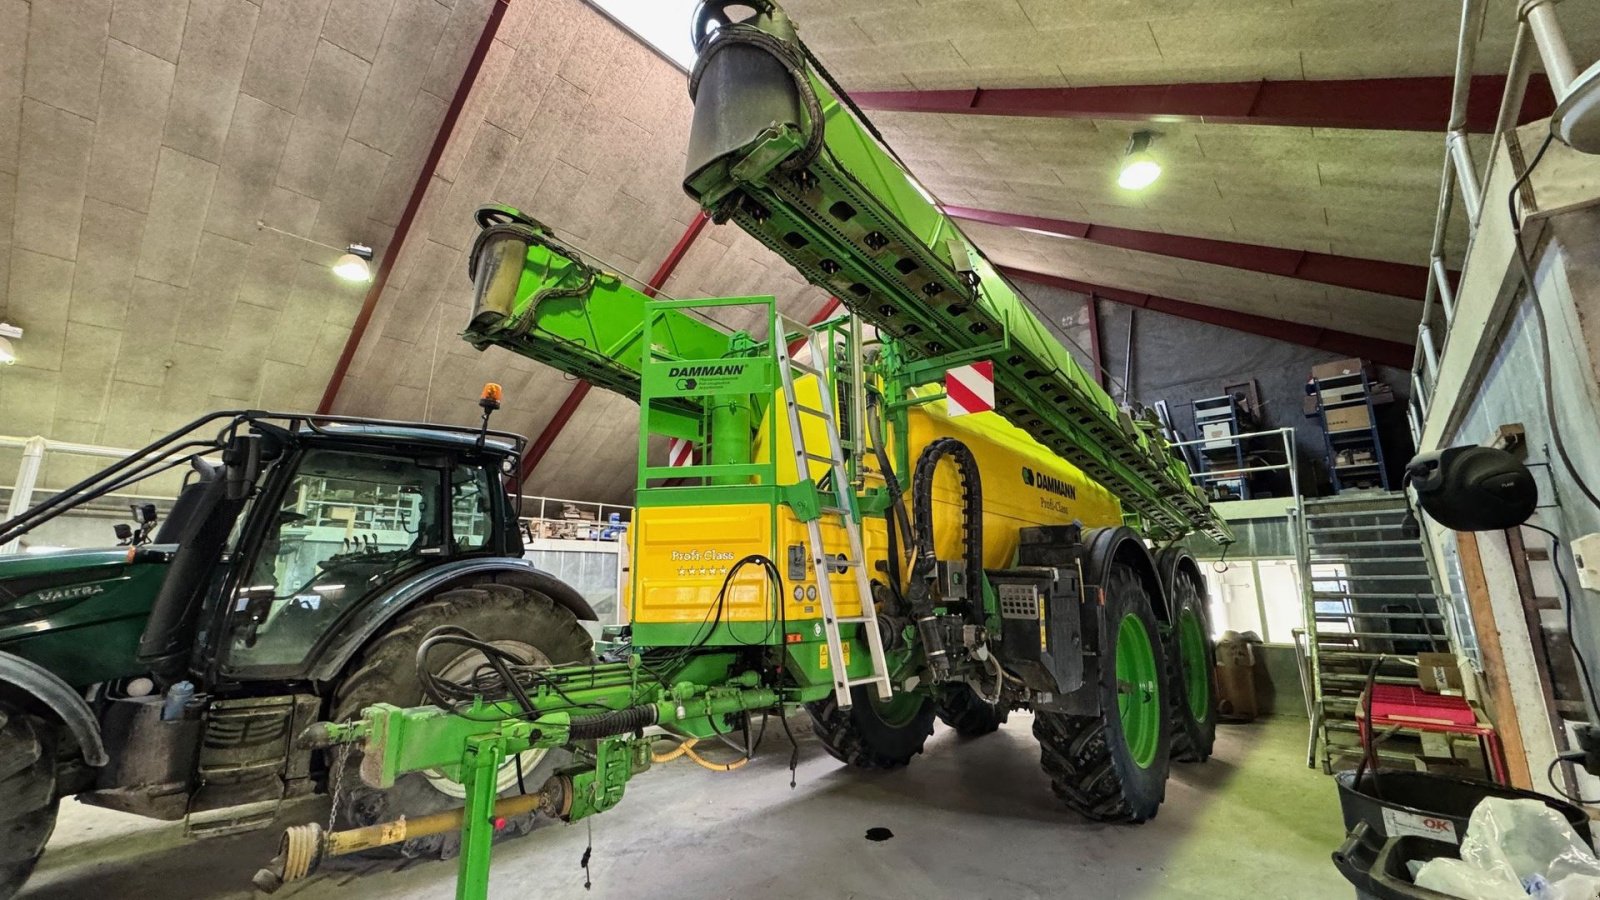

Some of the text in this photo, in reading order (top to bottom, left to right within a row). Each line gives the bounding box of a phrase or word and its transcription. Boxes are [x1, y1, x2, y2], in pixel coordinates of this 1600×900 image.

[668, 365, 744, 377] DAMMANN
[1036, 471, 1076, 501] DAMMANN
[38, 585, 104, 601] VALTRA
[1423, 818, 1450, 833] OK
